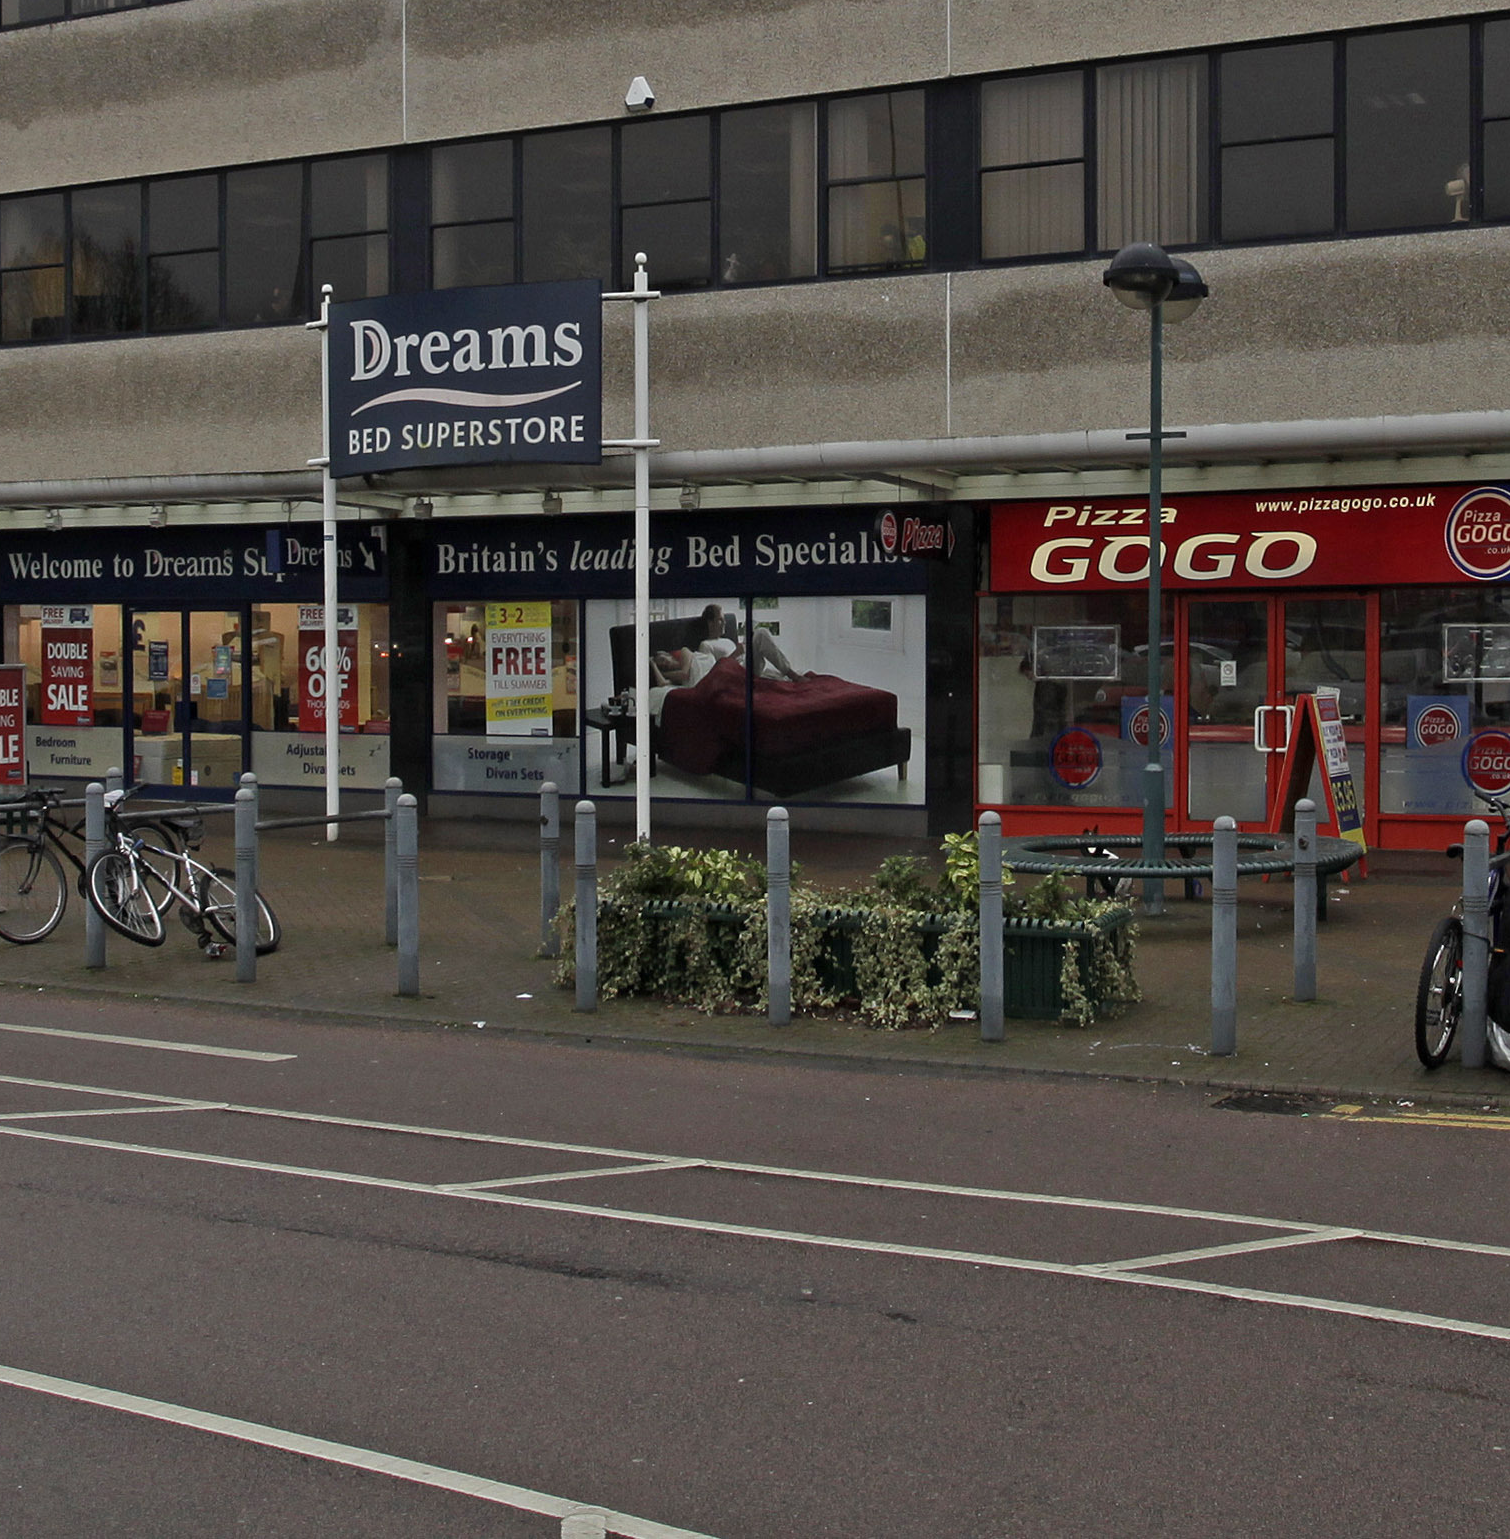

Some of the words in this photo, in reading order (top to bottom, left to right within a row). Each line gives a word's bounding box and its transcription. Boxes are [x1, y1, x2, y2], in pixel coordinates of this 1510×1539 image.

[350, 319, 583, 381] Dreams
[348, 427, 390, 455] BED
[401, 415, 585, 450] SUPERSTORE
[1255, 493, 1436, 514] www.pizzagogo.co.uk
[1043, 505, 1177, 527] Pizza
[1463, 510, 1501, 523] Pizza
[901, 517, 943, 553] Pizza
[286, 538, 352, 568] Dres
[438, 541, 558, 575] Britain's
[686, 535, 741, 568] Bed
[1030, 531, 1317, 583] GOGO
[9, 552, 102, 579] Welcome
[113, 554, 134, 578] to
[42, 607, 64, 618] FREE
[300, 609, 324, 620] FREE
[499, 608, 507, 623] 3
[515, 608, 523, 623] 2
[491, 632, 546, 644] EVERYTHING
[47, 643, 88, 659] DOUBLE
[492, 647, 546, 675] FREE
[51, 665, 84, 678] SAVING
[308, 673, 348, 698] OF
[493, 680, 508, 689] TILL
[511, 680, 547, 689] SUMMER
[47, 684, 88, 711] SALE
[307, 700, 350, 709] THOUDS
[1134, 724, 1164, 733] GOO
[1421, 724, 1454, 734] GOGO
[36, 737, 76, 748] Bedroom
[286, 744, 341, 758] Adjusta
[468, 748, 510, 762] Storage
[50, 754, 91, 765] Furniture
[303, 763, 327, 774] Diva
[339, 764, 356, 775] ets
[486, 768, 517, 780] Divan
[521, 769, 544, 780] Sets
